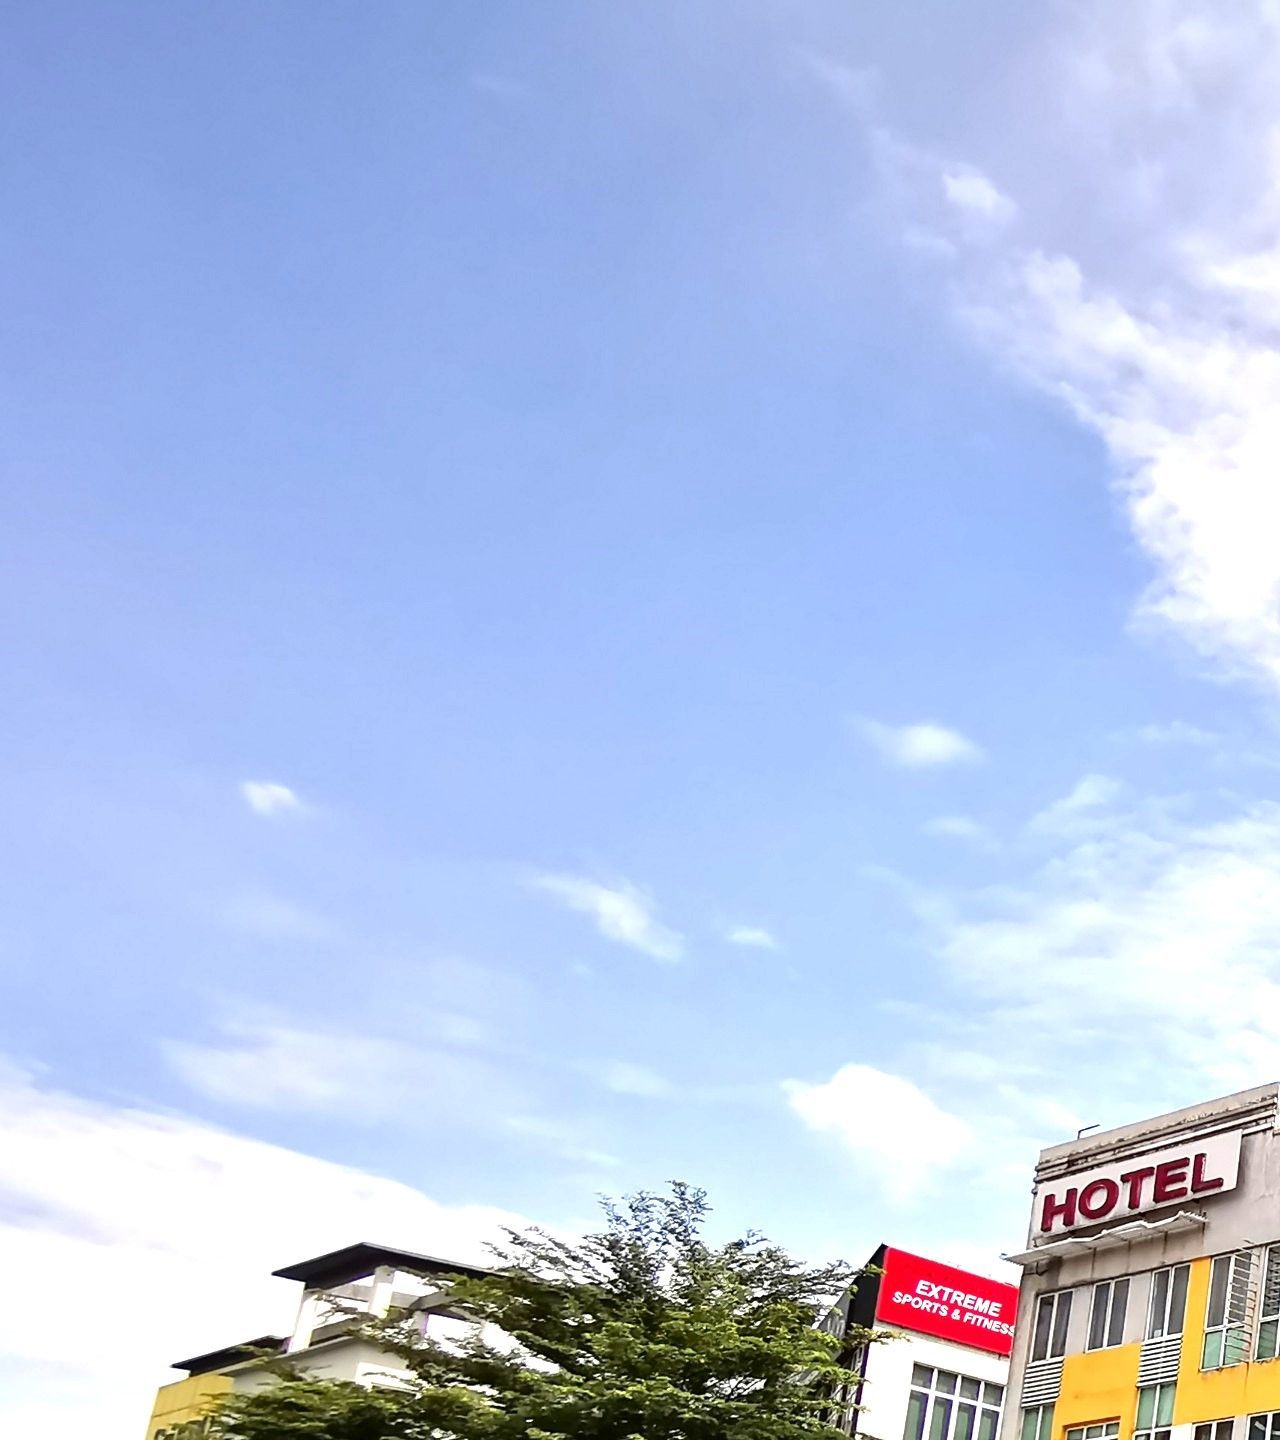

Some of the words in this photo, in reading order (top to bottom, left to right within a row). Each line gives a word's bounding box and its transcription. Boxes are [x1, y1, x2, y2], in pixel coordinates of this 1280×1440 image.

[1040, 1152, 1224, 1232] HOTEL
[892, 1291, 948, 1317] SPORTS
[951, 1309, 961, 1321] &
[916, 1280, 1003, 1317] EXTREME
